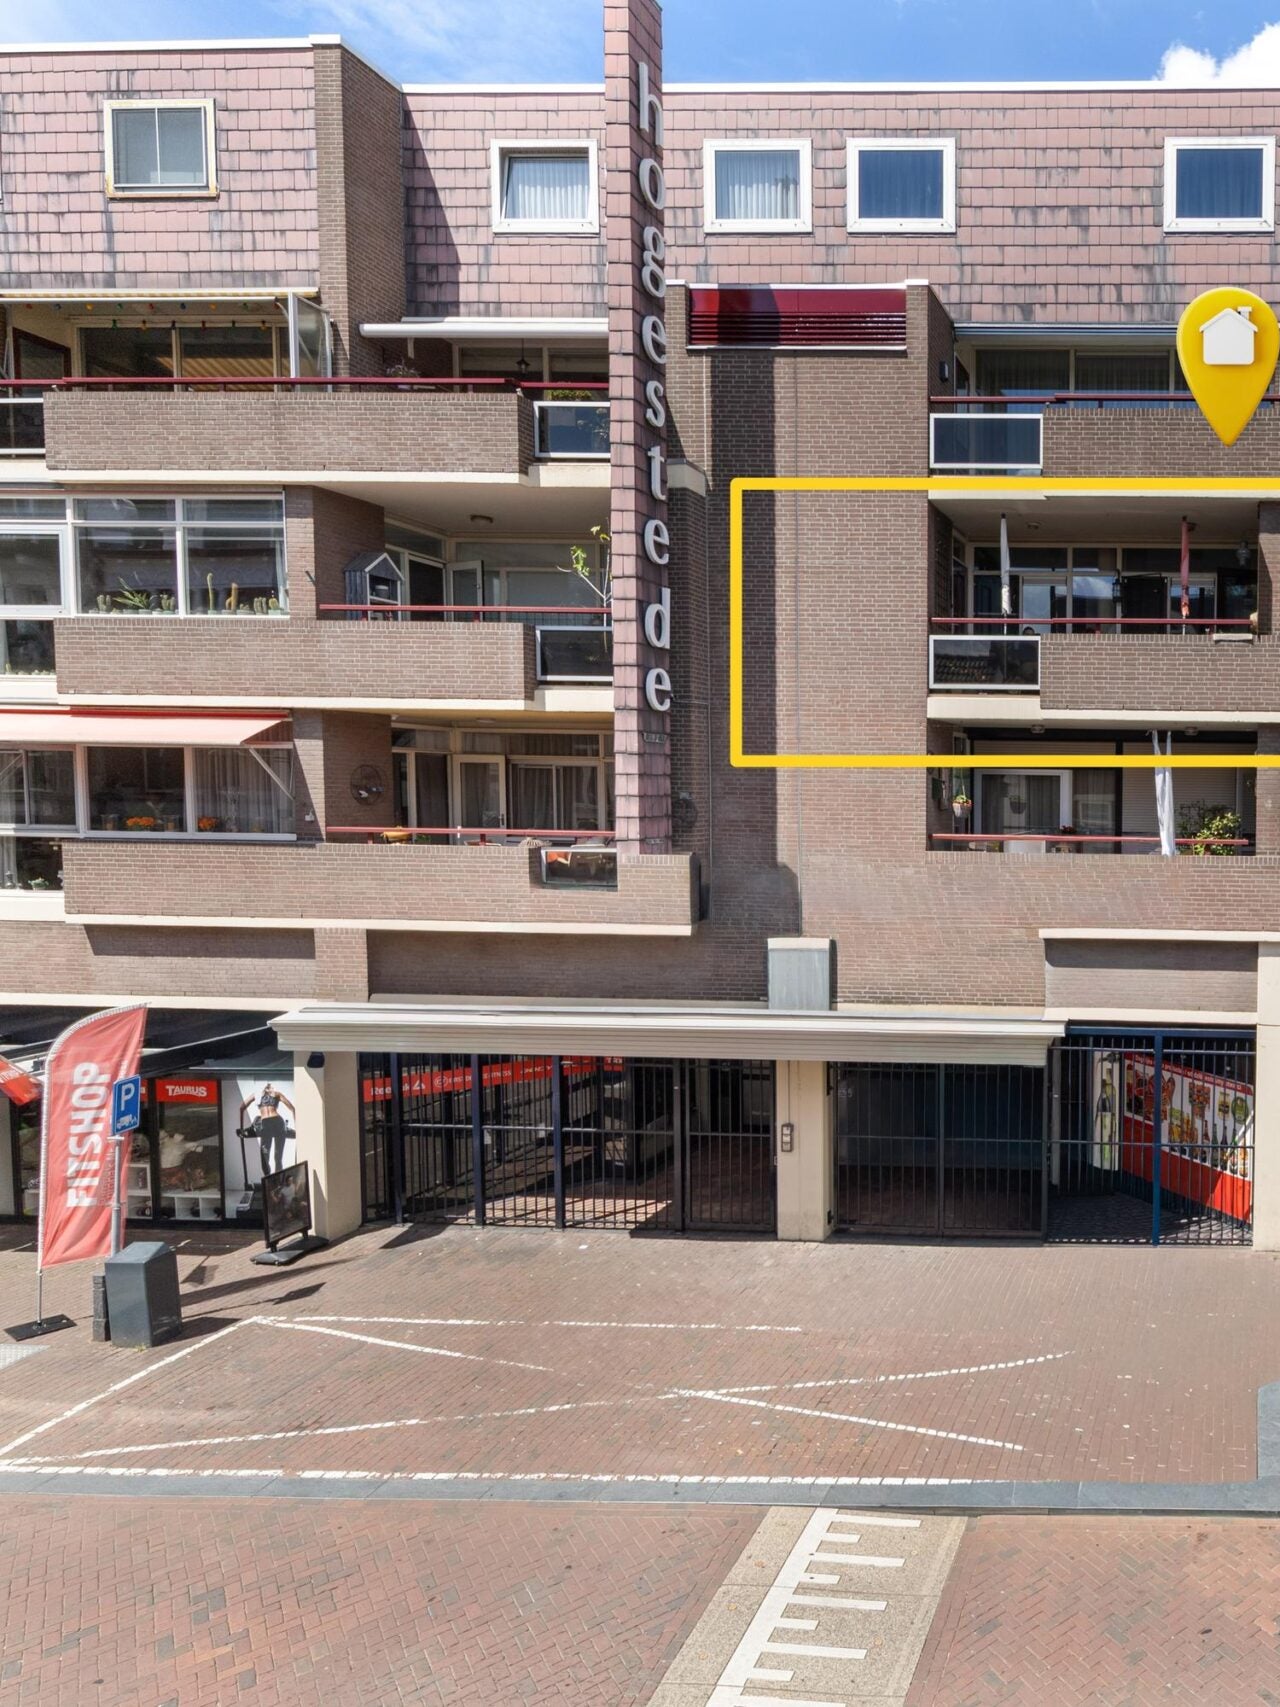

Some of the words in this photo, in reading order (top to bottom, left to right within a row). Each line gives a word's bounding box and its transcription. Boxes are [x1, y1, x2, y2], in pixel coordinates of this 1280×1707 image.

[637, 62, 671, 712] hogestede
[121, 1083, 135, 1111] P
[165, 1085, 207, 1097] TAURUS
[66, 1062, 111, 1207] FITSHOP
